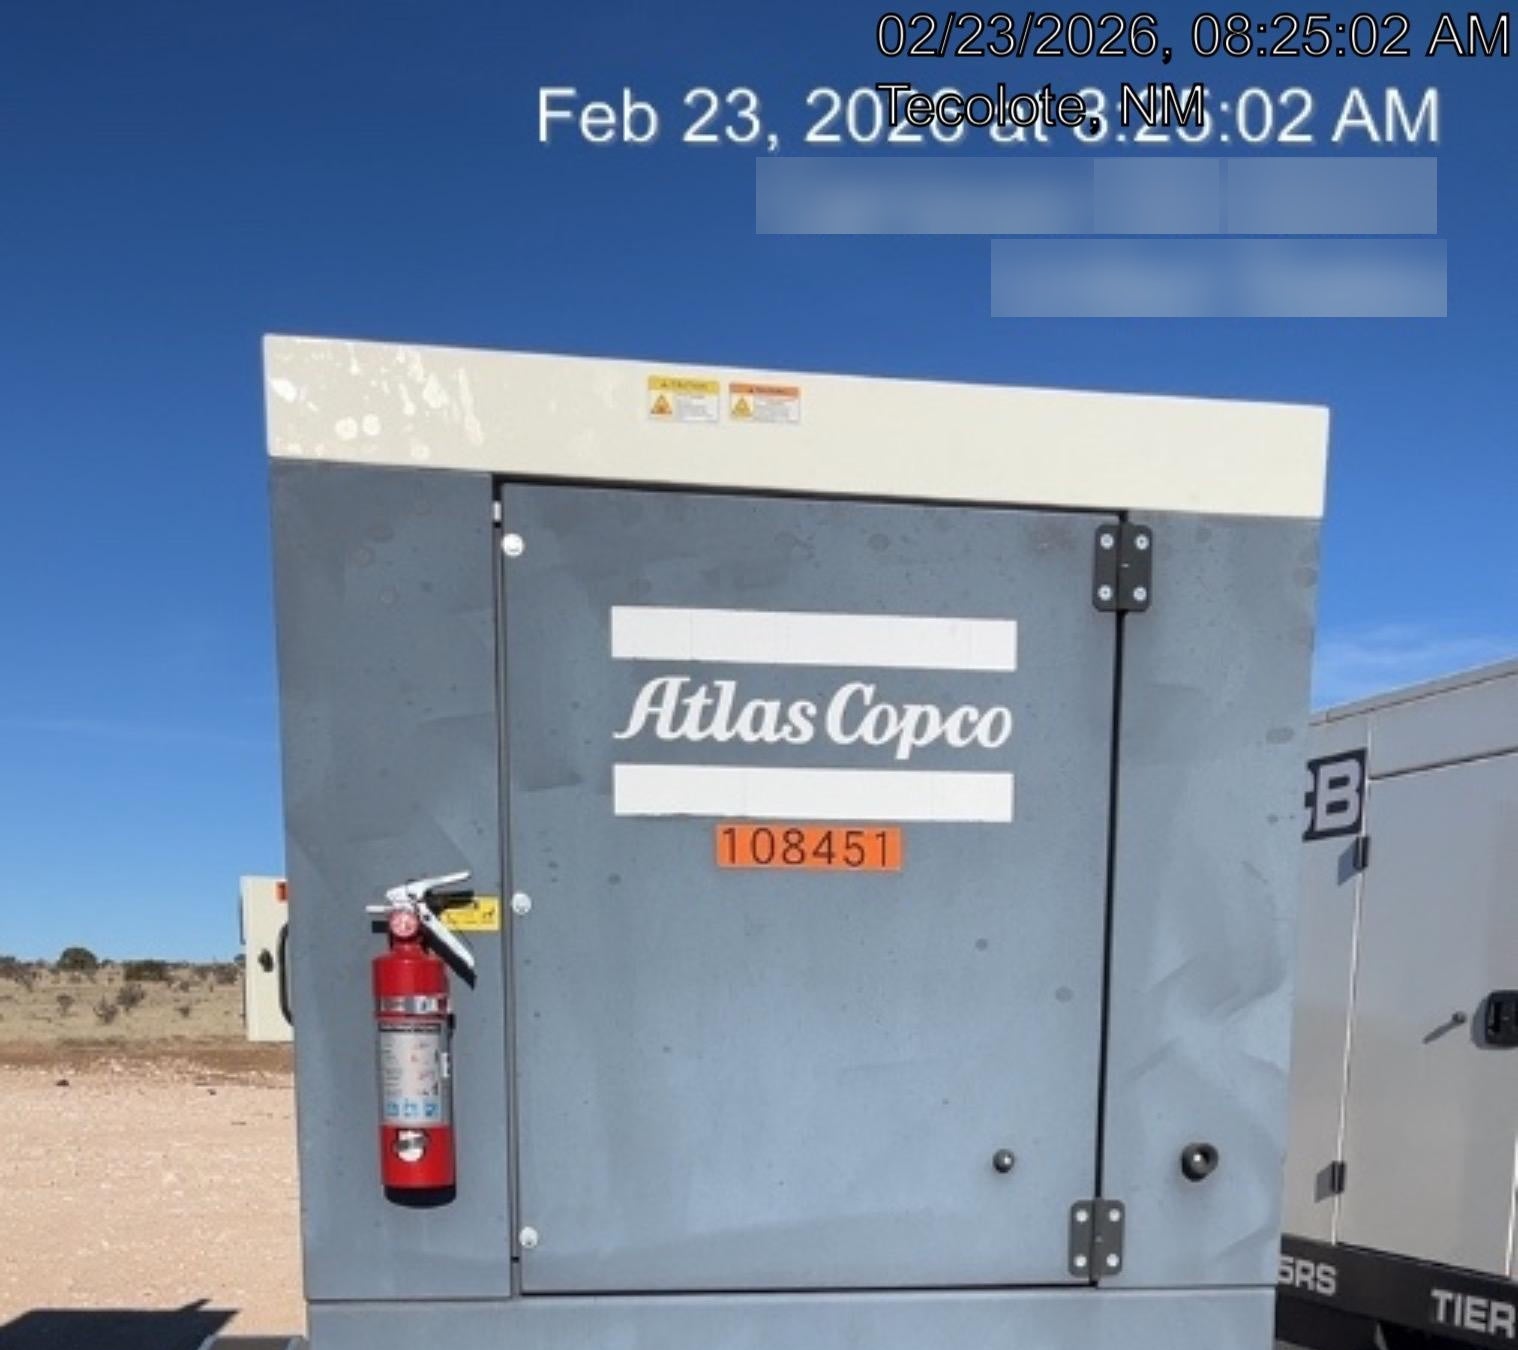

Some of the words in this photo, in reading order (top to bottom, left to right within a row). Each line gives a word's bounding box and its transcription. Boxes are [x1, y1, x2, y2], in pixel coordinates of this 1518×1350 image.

[613, 675, 818, 745] Atlas
[826, 681, 1013, 760] Copco
[722, 826, 892, 868] 108451
[1430, 1288, 1516, 1339] TIER
